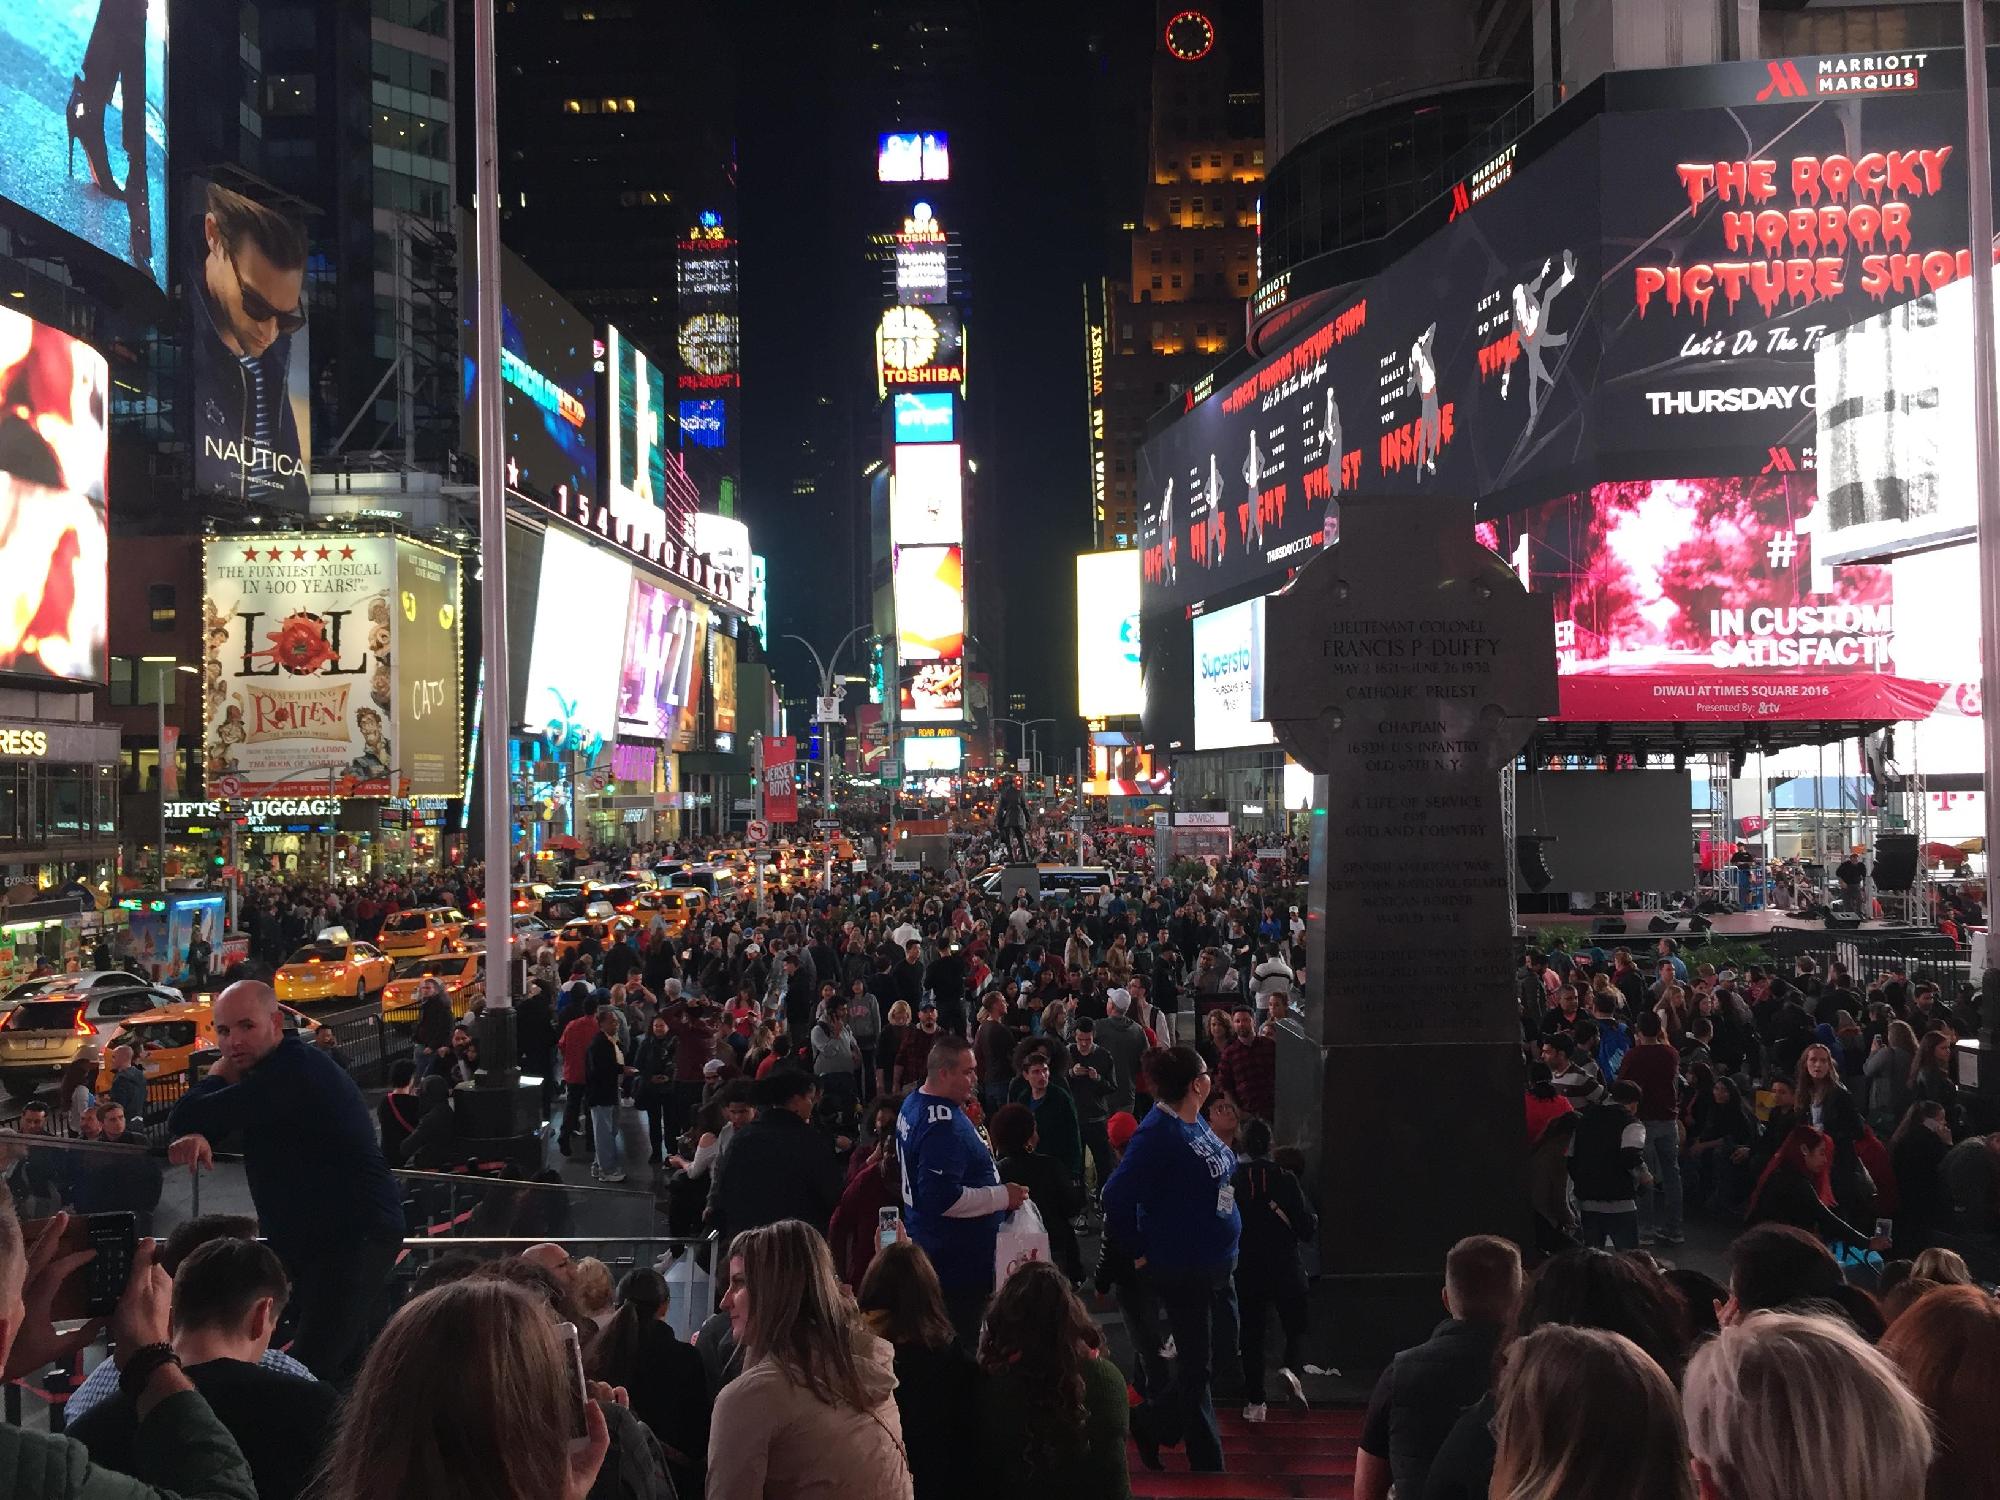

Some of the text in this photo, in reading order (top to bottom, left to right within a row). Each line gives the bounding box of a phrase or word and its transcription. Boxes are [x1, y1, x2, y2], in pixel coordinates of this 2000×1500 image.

[1818, 54, 1928, 74] MARRIOTT
[1818, 73, 1916, 91] MARQUIS
[1472, 144, 1518, 186] MARRIOTT
[1472, 164, 1512, 201] MARQUIS
[1676, 145, 1953, 218] THE ROCKY
[896, 232, 946, 243] TOSHIBA
[1722, 203, 1912, 260] HORROR
[1254, 271, 1292, 304] MARRIOTT
[1635, 258, 1845, 328] PICTURE
[1254, 290, 1287, 318] MARQUIS
[1477, 290, 1501, 312] LET'S
[1477, 310, 1510, 336] DO THE
[1680, 328, 1799, 357] Let's Do The
[1090, 325, 1103, 397] WHISKY
[1380, 351, 1397, 369] THAT
[1477, 331, 1521, 383] TIME
[885, 367, 961, 383] TOSHIBA
[1380, 365, 1405, 387] REALLY
[1380, 386, 1404, 407] DRIVES
[1380, 410, 1395, 424] YOU
[204, 434, 310, 482] NAUTICA
[217, 563, 382, 578] THE FUNNIEST MUSICAL
[242, 579, 256, 594] IN
[264, 580, 297, 594] 400
[1332, 619, 1485, 635] LIEUTENANT COLONEL
[1711, 609, 1747, 637] IN
[1322, 639, 1405, 657] FRANCIS
[1431, 638, 1501, 657] DUFFY
[1333, 663, 1360, 675] MAY
[263, 688, 337, 701] SOMETHING
[412, 678, 445, 720] CATS
[1345, 684, 1479, 700] CATHOLIC PRIEST
[1653, 684, 1830, 698] DIWALI AT TIMES SQUARE 2016
[1696, 702, 1741, 713] Presented
[1743, 702, 1756, 715] By:
[1378, 720, 1448, 734] CHAPLAIN
[1418, 740, 1481, 753] INFANTRY
[765, 761, 795, 782] JERSEY
[769, 780, 791, 797] BOYS
[163, 800, 221, 818] GIFTS
[251, 825, 282, 833] SONY
[927, 1104, 953, 1124] 10
